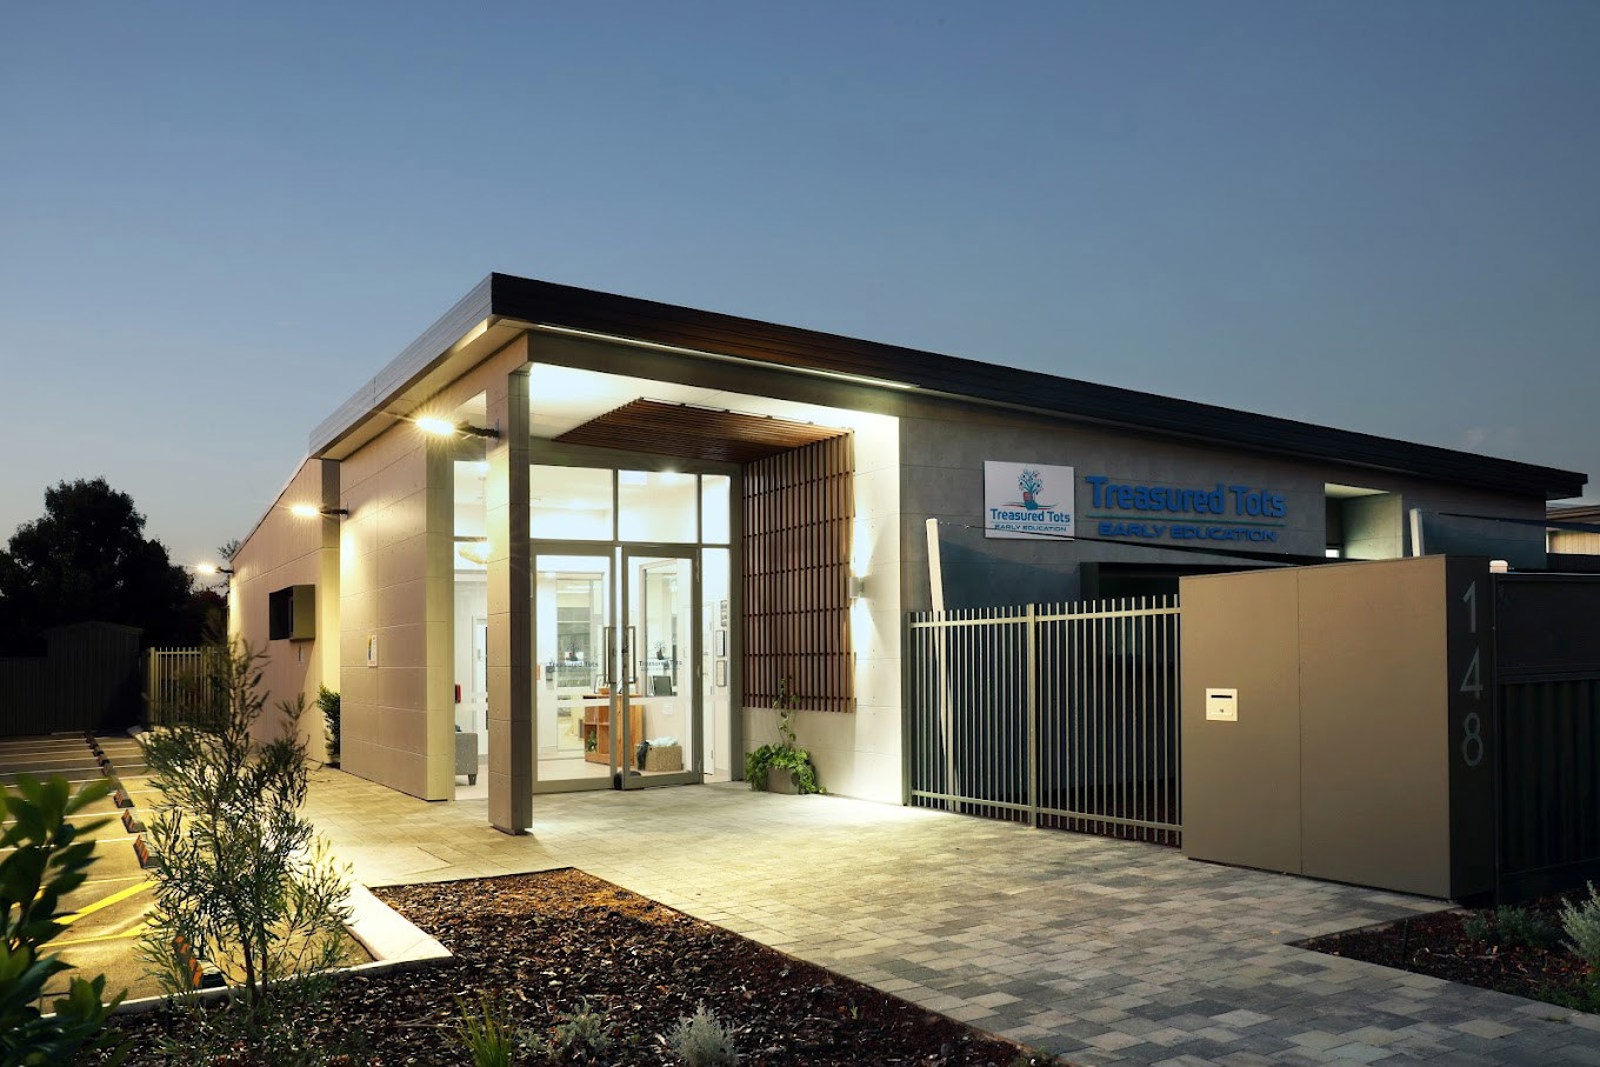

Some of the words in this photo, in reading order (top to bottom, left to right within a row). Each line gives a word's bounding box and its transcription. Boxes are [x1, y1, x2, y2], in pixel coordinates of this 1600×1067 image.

[1084, 475, 1225, 514] Treasured
[1229, 485, 1286, 517] Tots
[990, 508, 1044, 522] Treasured
[1047, 511, 1071, 523] Tots
[1098, 521, 1166, 538] EARLY
[1170, 525, 1279, 543] EDUCATION
[1459, 580, 1484, 767] 148
